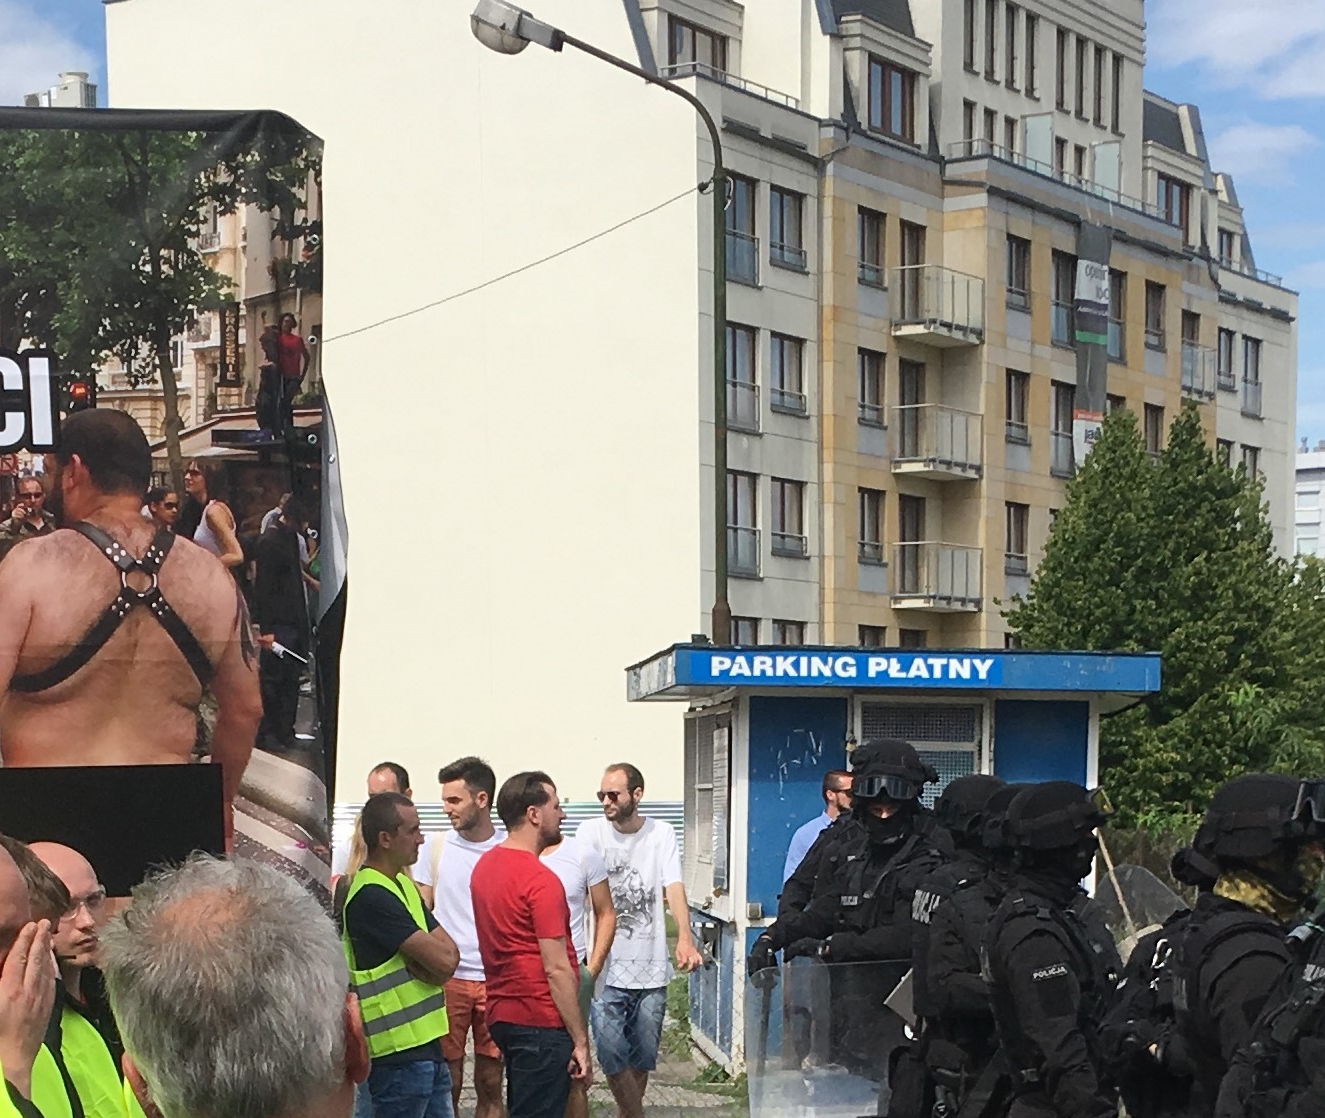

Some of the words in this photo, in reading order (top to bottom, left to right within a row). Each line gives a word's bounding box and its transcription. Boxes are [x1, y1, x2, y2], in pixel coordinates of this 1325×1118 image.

[710, 656, 857, 678] PARKING
[867, 657, 995, 680] PŁATNY
[1032, 965, 1068, 979] POLICJA
